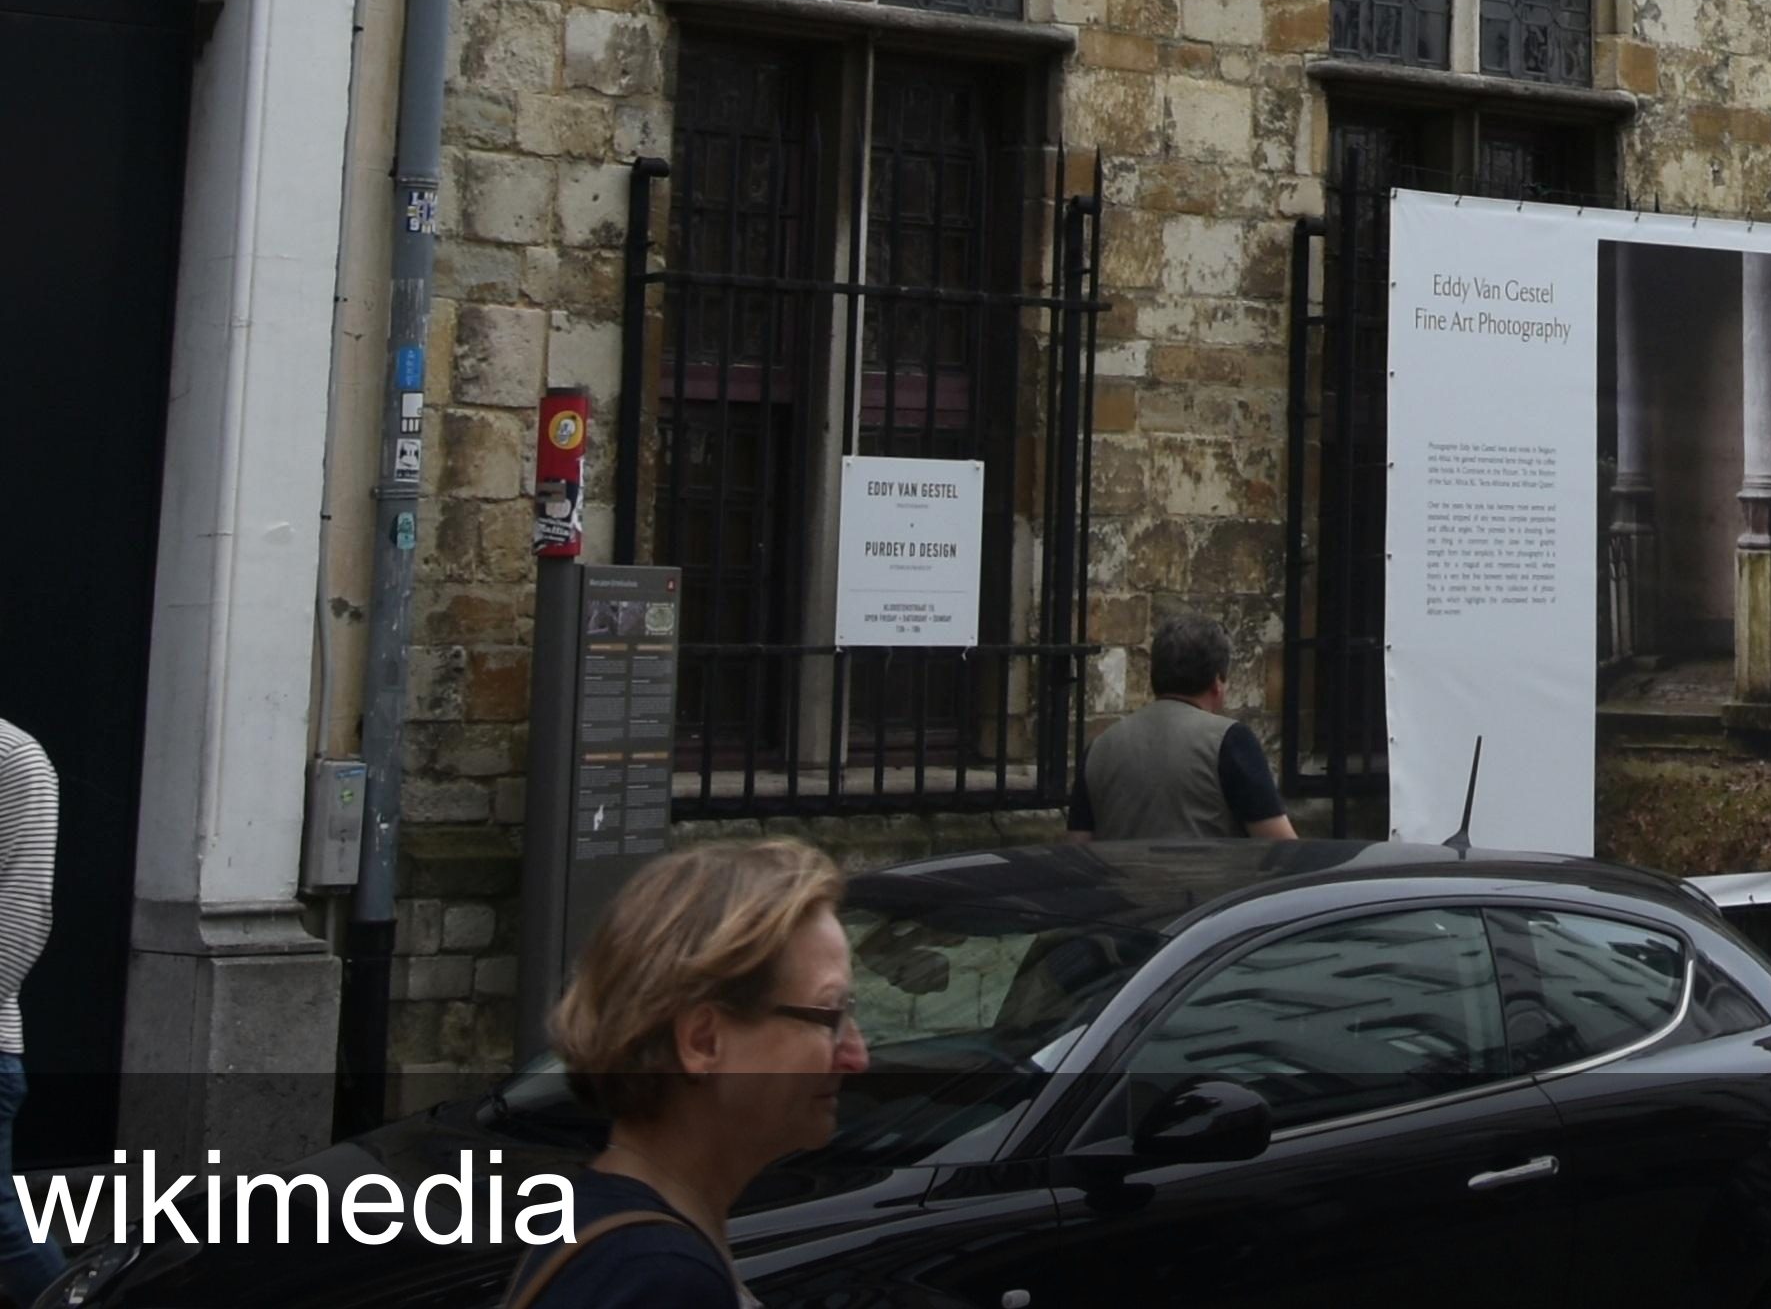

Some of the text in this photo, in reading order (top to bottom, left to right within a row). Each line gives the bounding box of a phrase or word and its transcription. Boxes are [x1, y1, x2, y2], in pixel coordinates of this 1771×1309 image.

[1433, 273, 1553, 304] Eddy Van Gestel
[1415, 307, 1571, 344] Fine Art Photography
[867, 480, 958, 499] EDDY VAN GESTEL
[865, 541, 957, 558] PURDEY D DESIGN
